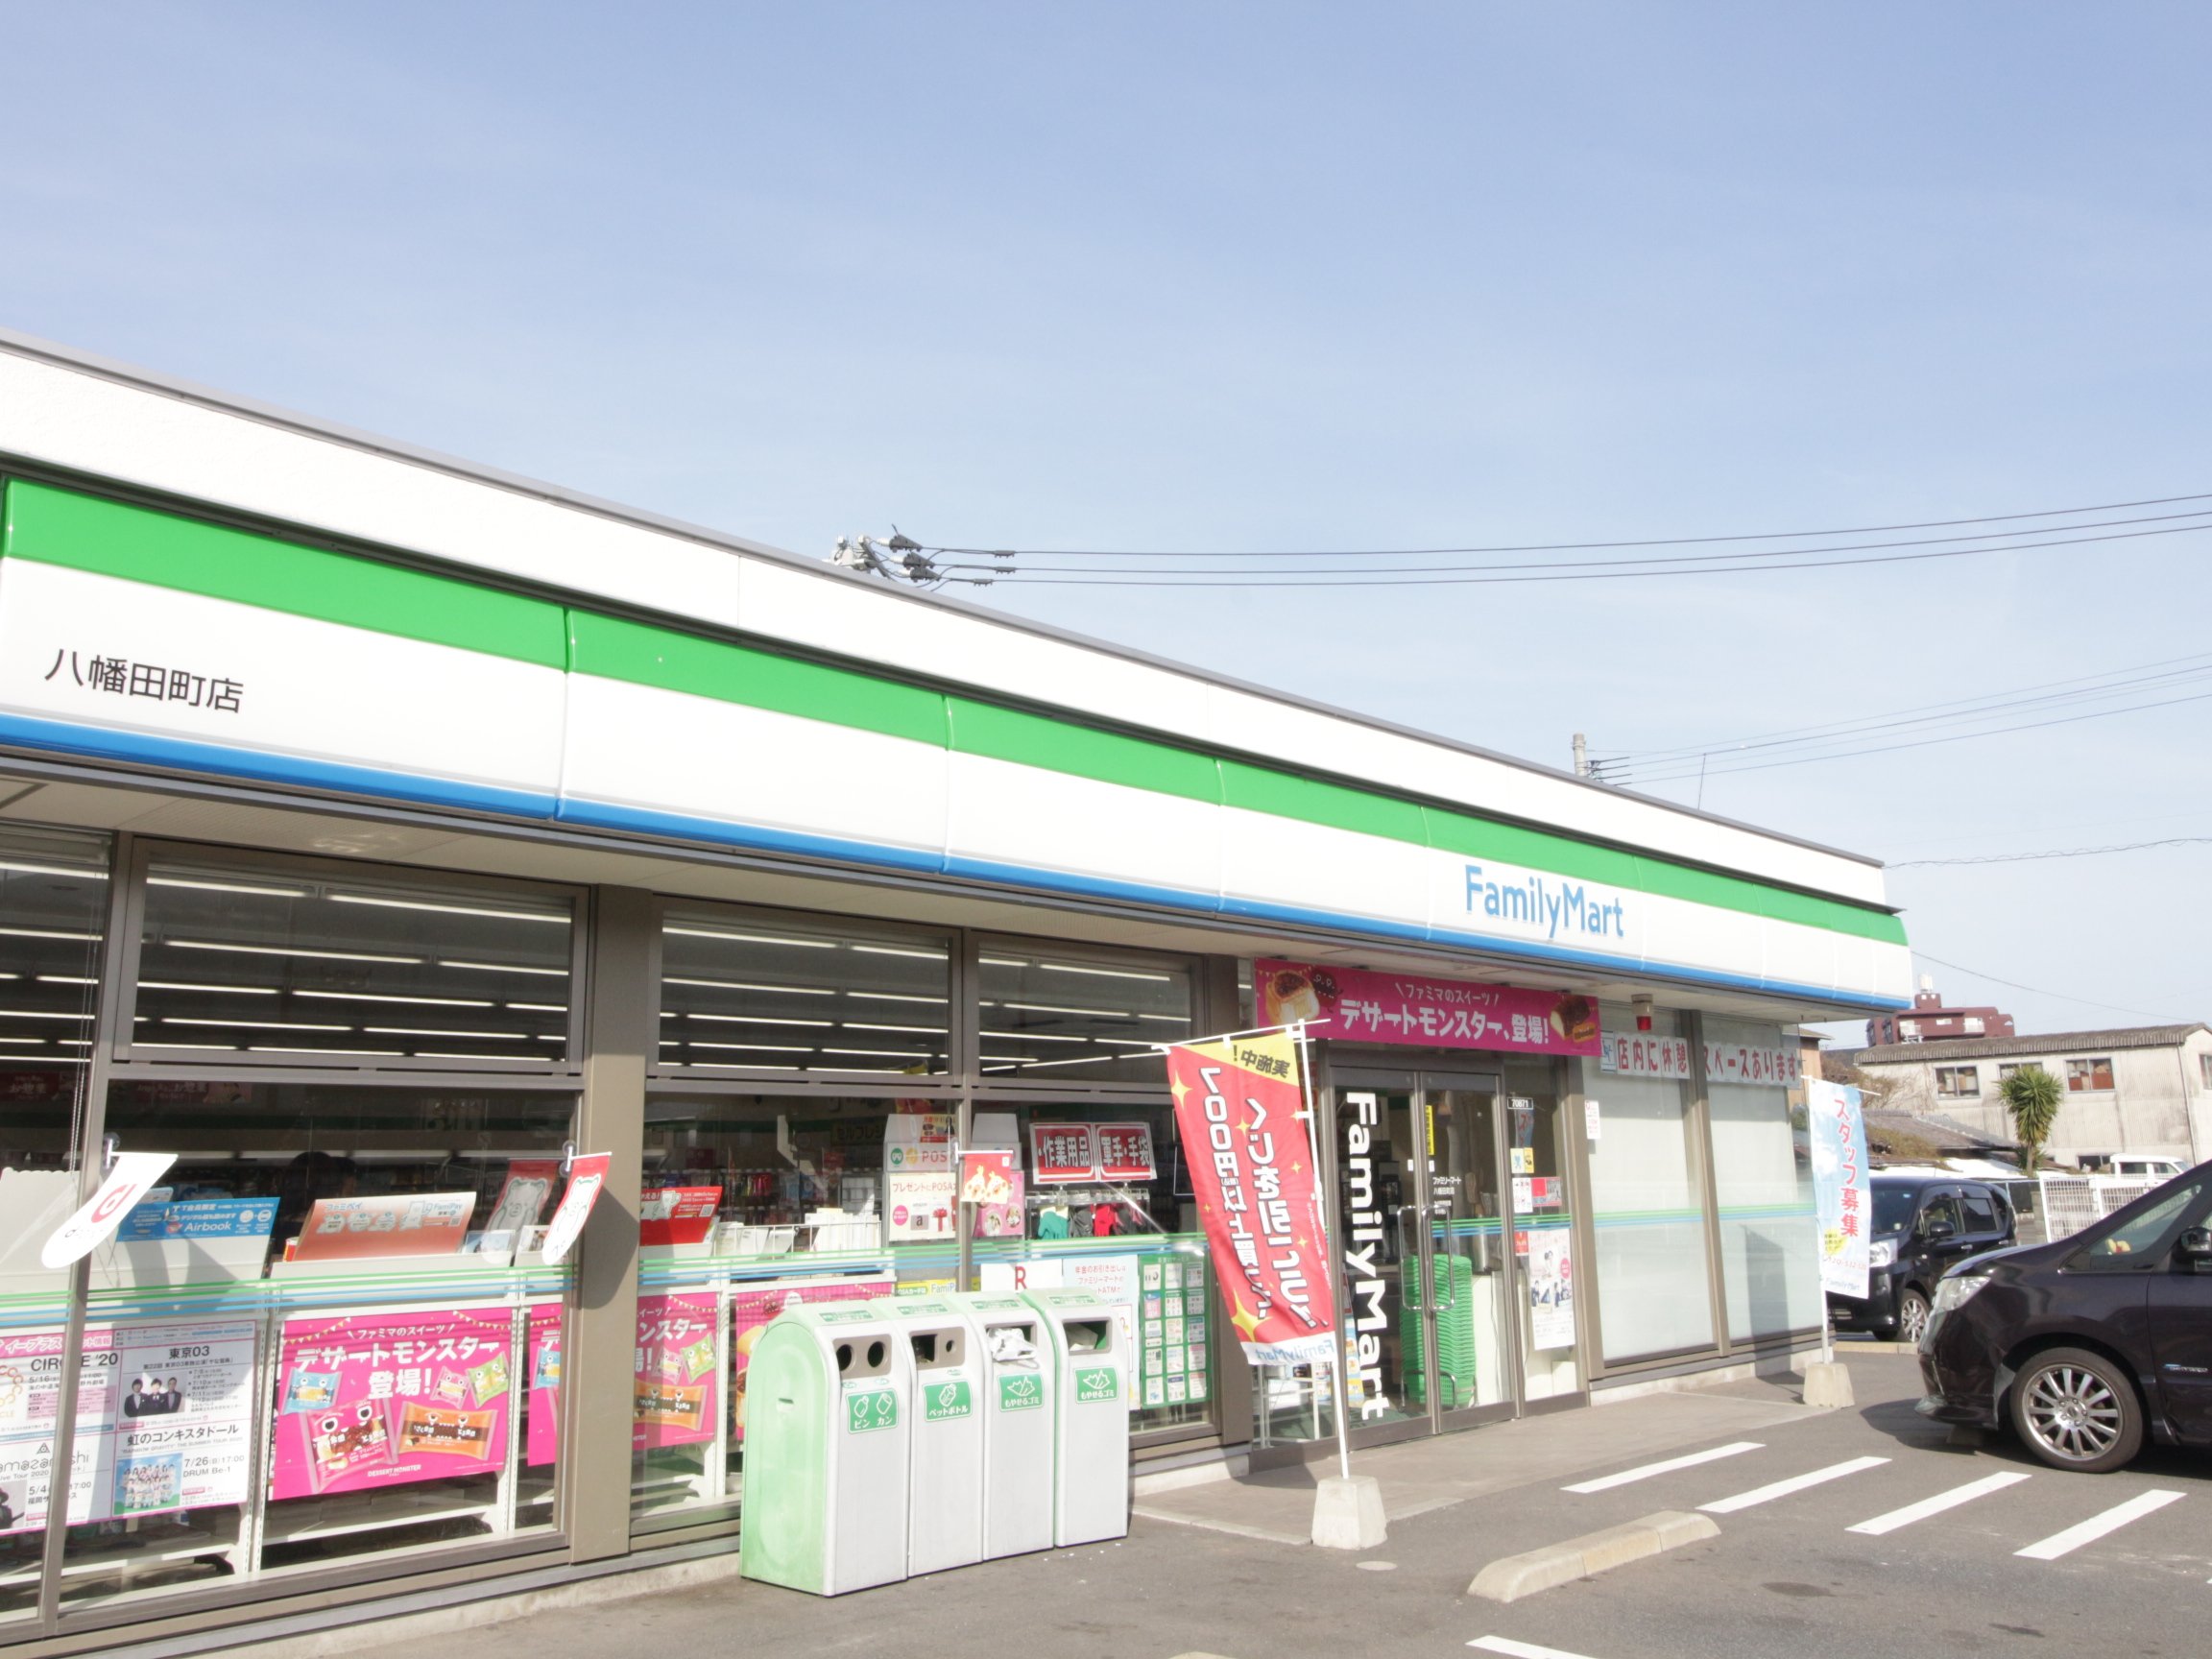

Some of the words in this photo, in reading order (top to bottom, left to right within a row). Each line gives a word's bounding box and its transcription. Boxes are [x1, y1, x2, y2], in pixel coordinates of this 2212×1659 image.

[44, 648, 244, 713] 八幡田町店
[1465, 864, 1623, 938] FamilyMart
[1404, 983, 1490, 1007] ファミマのスイーツ
[1617, 1037, 1687, 1074] 店内に休憩
[1835, 1099, 1859, 1237] スタッフ募集
[1346, 1092, 1390, 1421] FamilyMart
[357, 1324, 445, 1340] ファミマのスイーツ
[169, 1346, 210, 1359] 東京03
[294, 1337, 499, 1372] デザートモンスター
[368, 1368, 431, 1400] 登場!
[1081, 1389, 1115, 1399] もやせるゴミ
[928, 1405, 968, 1418] ペットボトル
[1004, 1397, 1041, 1407] もやせるゴミ
[854, 1418, 870, 1429] ビン
[877, 1415, 893, 1427] カン
[127, 1424, 239, 1447] 虹のコンキスタドール
[183, 1469, 209, 1479] DRUM
